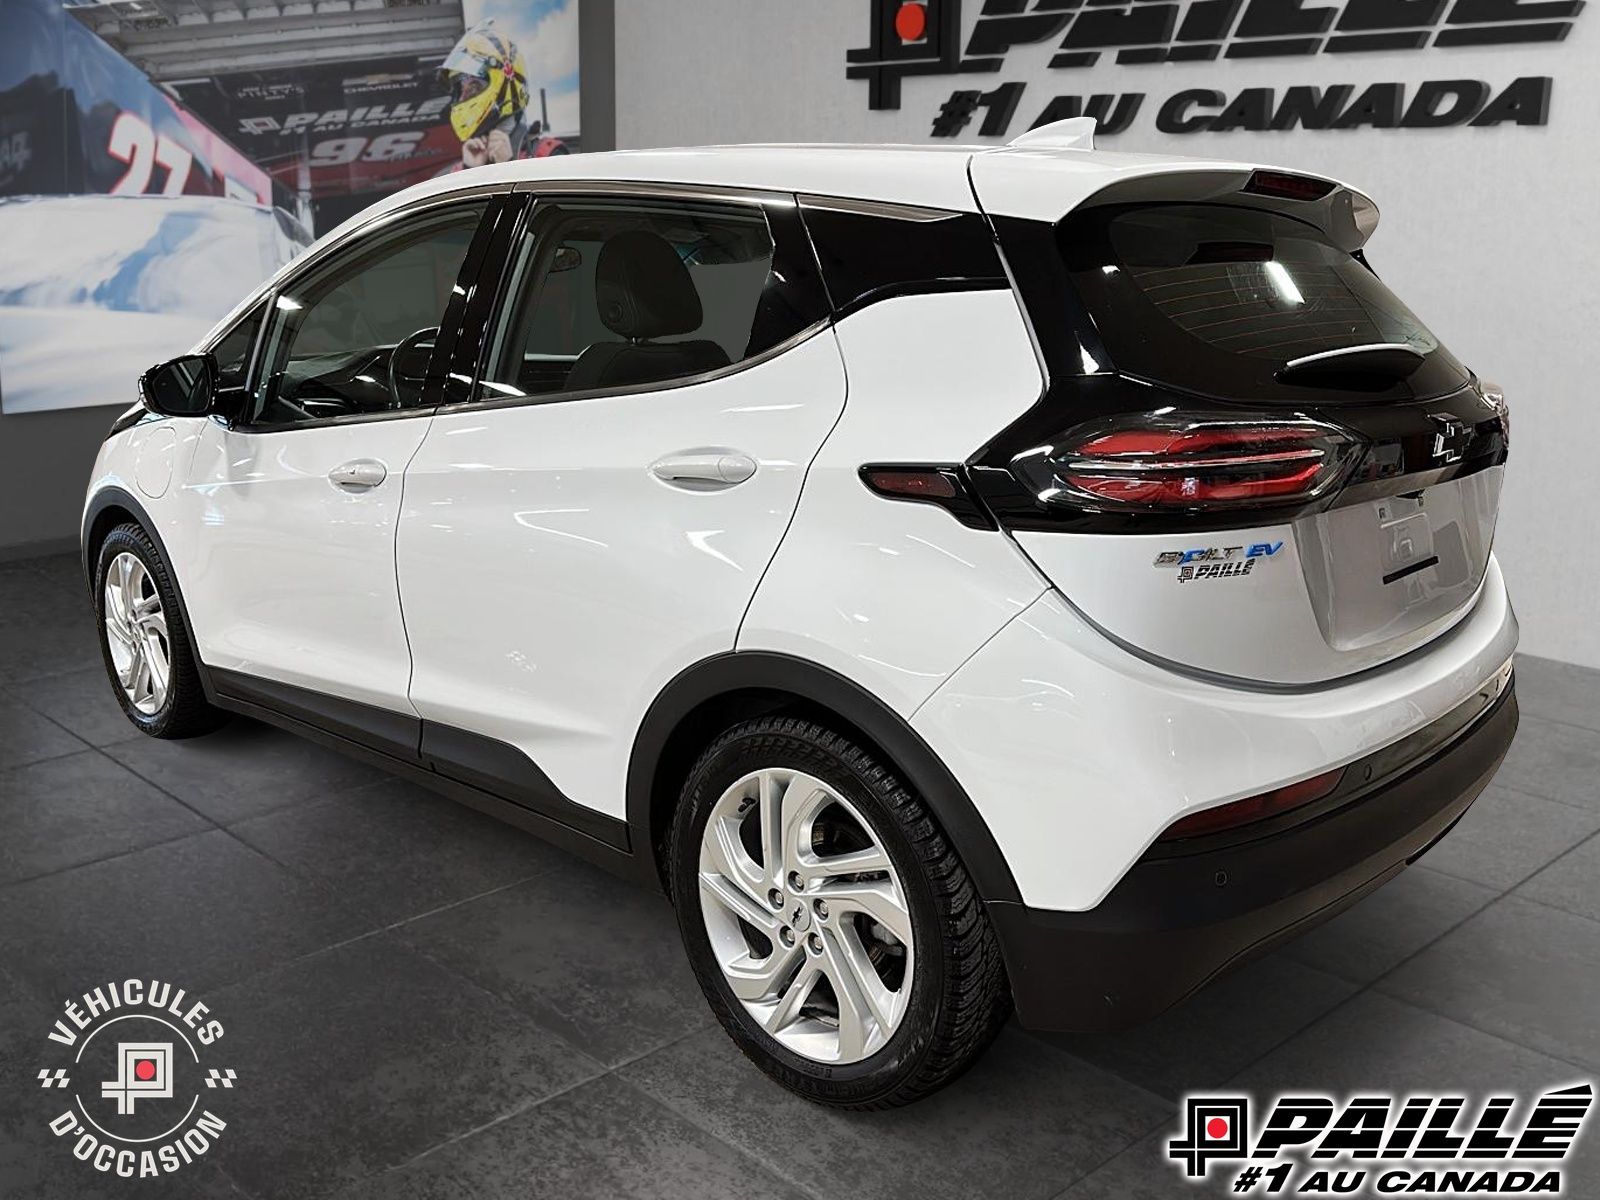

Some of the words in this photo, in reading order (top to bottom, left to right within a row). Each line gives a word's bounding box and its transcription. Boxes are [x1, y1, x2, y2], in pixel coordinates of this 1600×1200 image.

[313, 124, 344, 133] AU
[350, 114, 441, 128] CANADA
[930, 82, 1027, 137] #1
[1027, 93, 1146, 136] AU
[1154, 76, 1553, 134] CANADA
[108, 110, 193, 198] 27
[310, 131, 425, 167] 96
[1153, 546, 1243, 567] BOLT
[1246, 541, 1283, 558] EV
